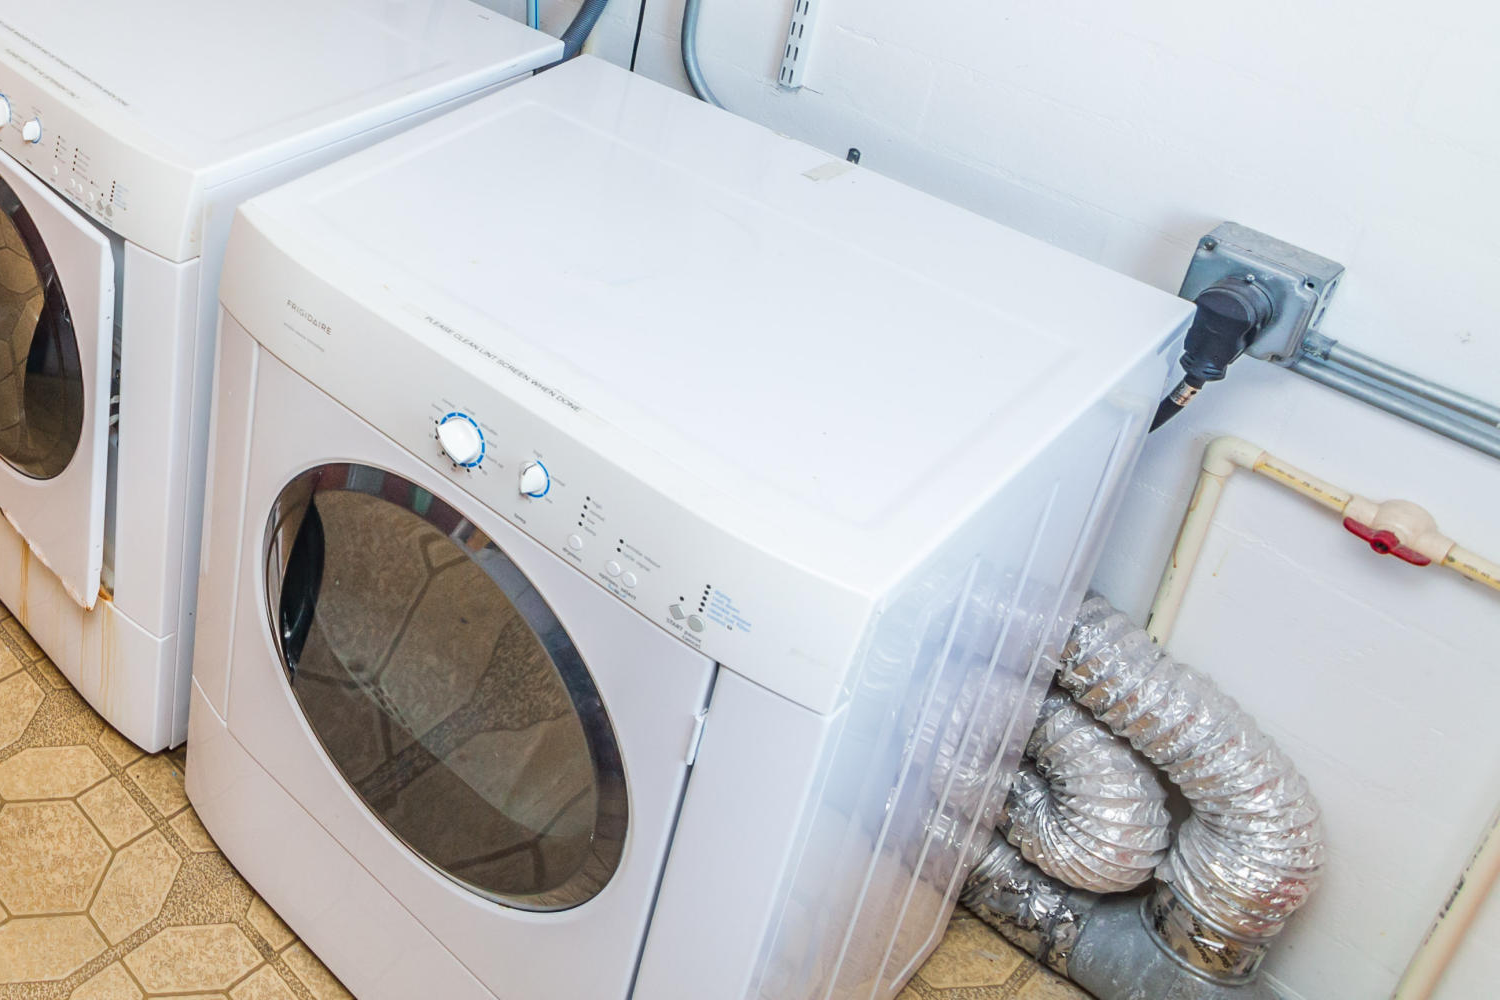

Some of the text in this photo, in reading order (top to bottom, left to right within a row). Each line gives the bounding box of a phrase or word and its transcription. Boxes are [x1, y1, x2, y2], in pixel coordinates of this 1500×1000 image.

[287, 299, 333, 336] FRIGIDAIRE
[424, 316, 581, 412] PLEASE CLEAN LINT SCREEN WHEN DONE
